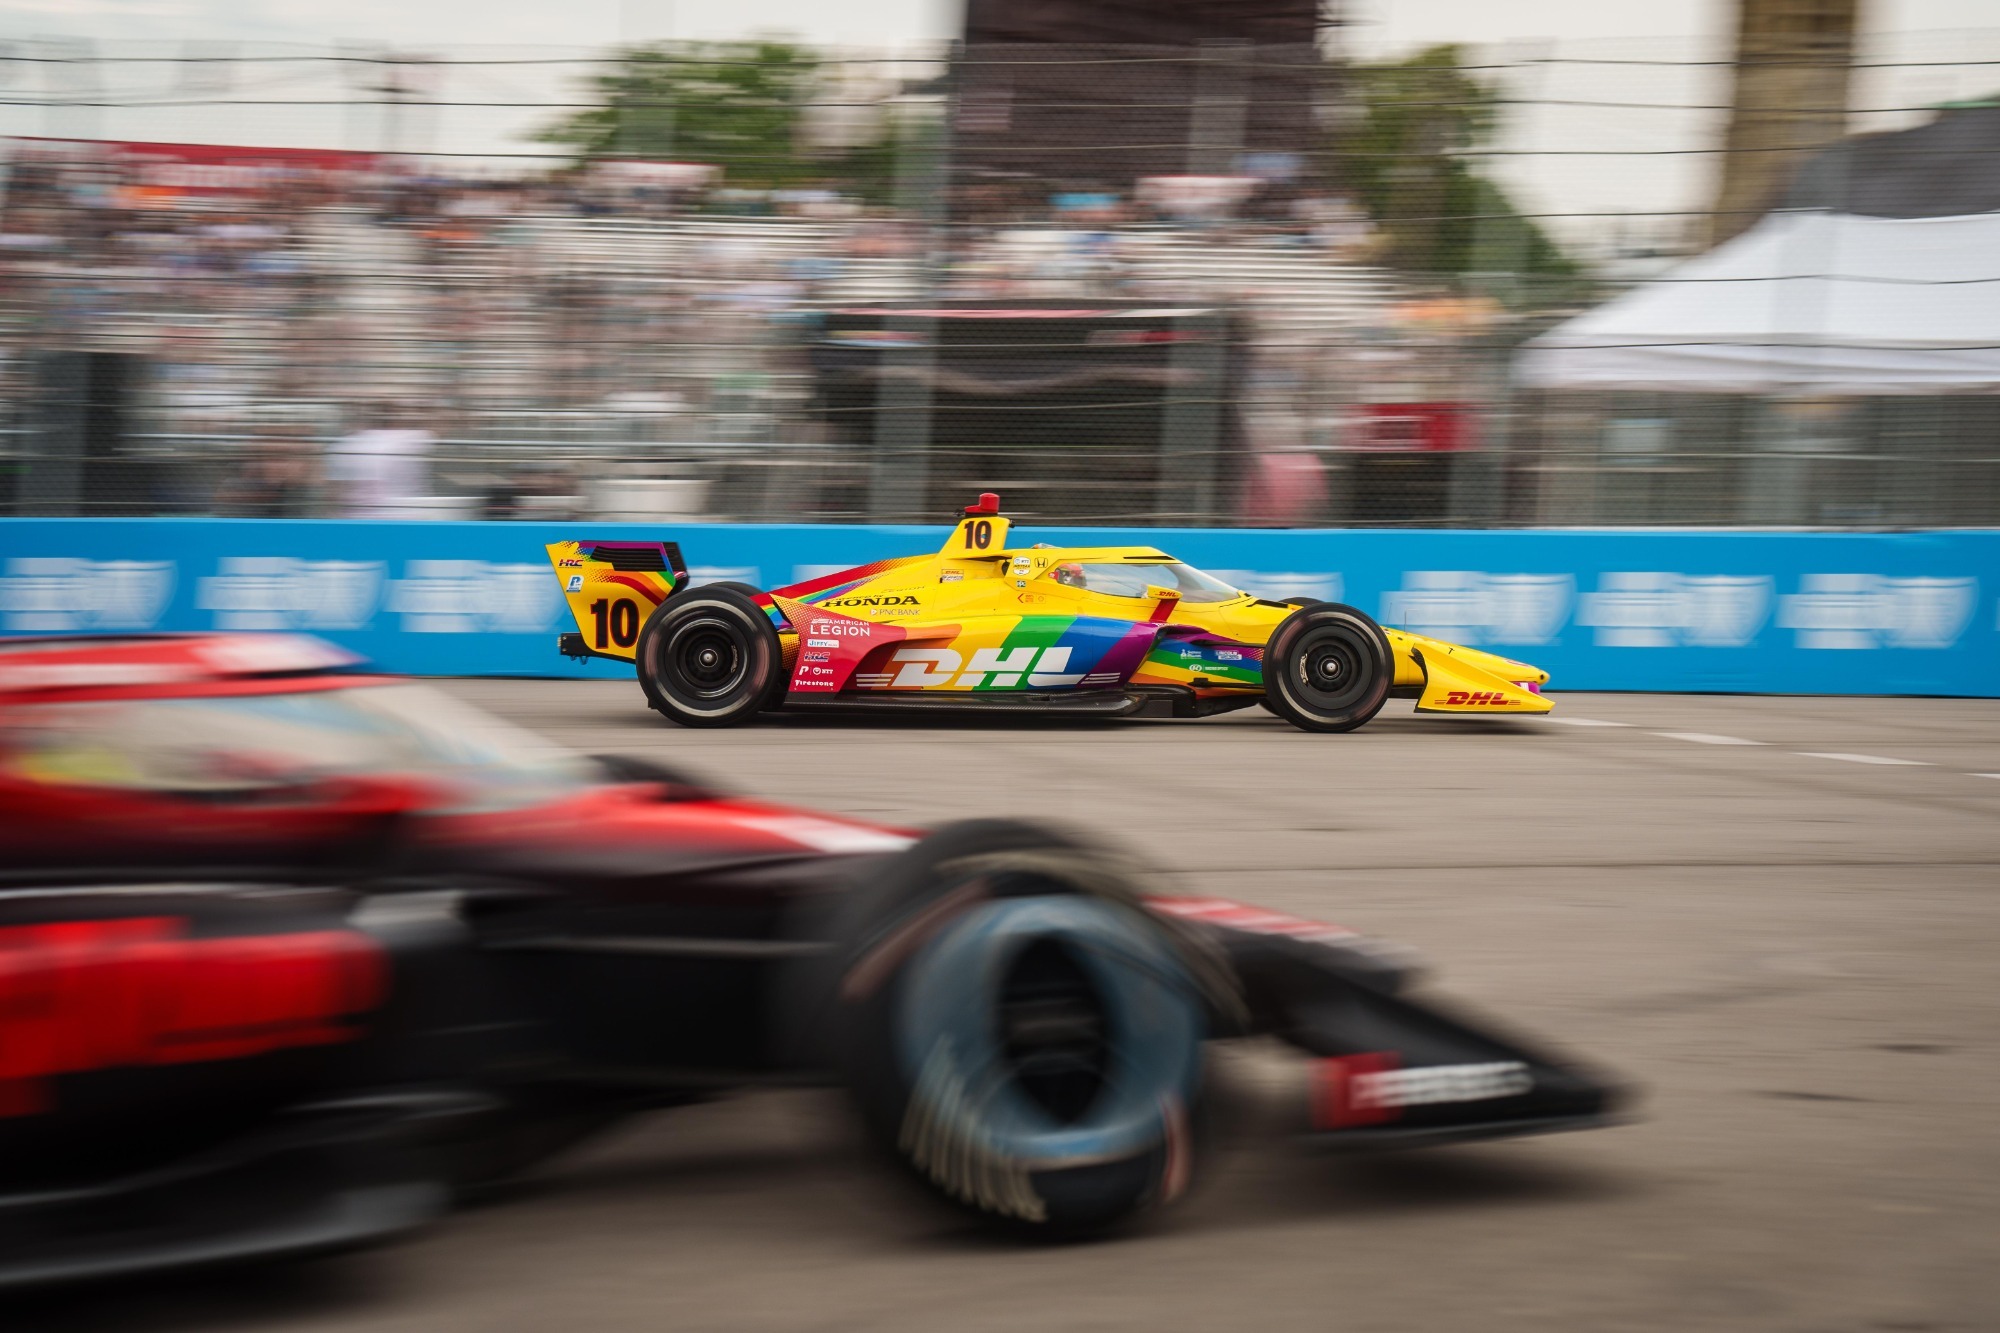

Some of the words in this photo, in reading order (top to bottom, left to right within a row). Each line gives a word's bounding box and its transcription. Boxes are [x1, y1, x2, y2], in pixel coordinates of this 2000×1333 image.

[964, 520, 992, 550] 10
[558, 558, 584, 567] HRC
[822, 595, 921, 608] HONDA
[879, 608, 895, 616] PNC
[897, 608, 920, 616] BANK
[590, 598, 640, 649] 10
[828, 619, 870, 627] AMERICAN
[810, 624, 871, 637] LEGION
[891, 646, 1087, 687] DHL
[794, 679, 834, 687] Firestone
[1445, 691, 1509, 705] DHL
